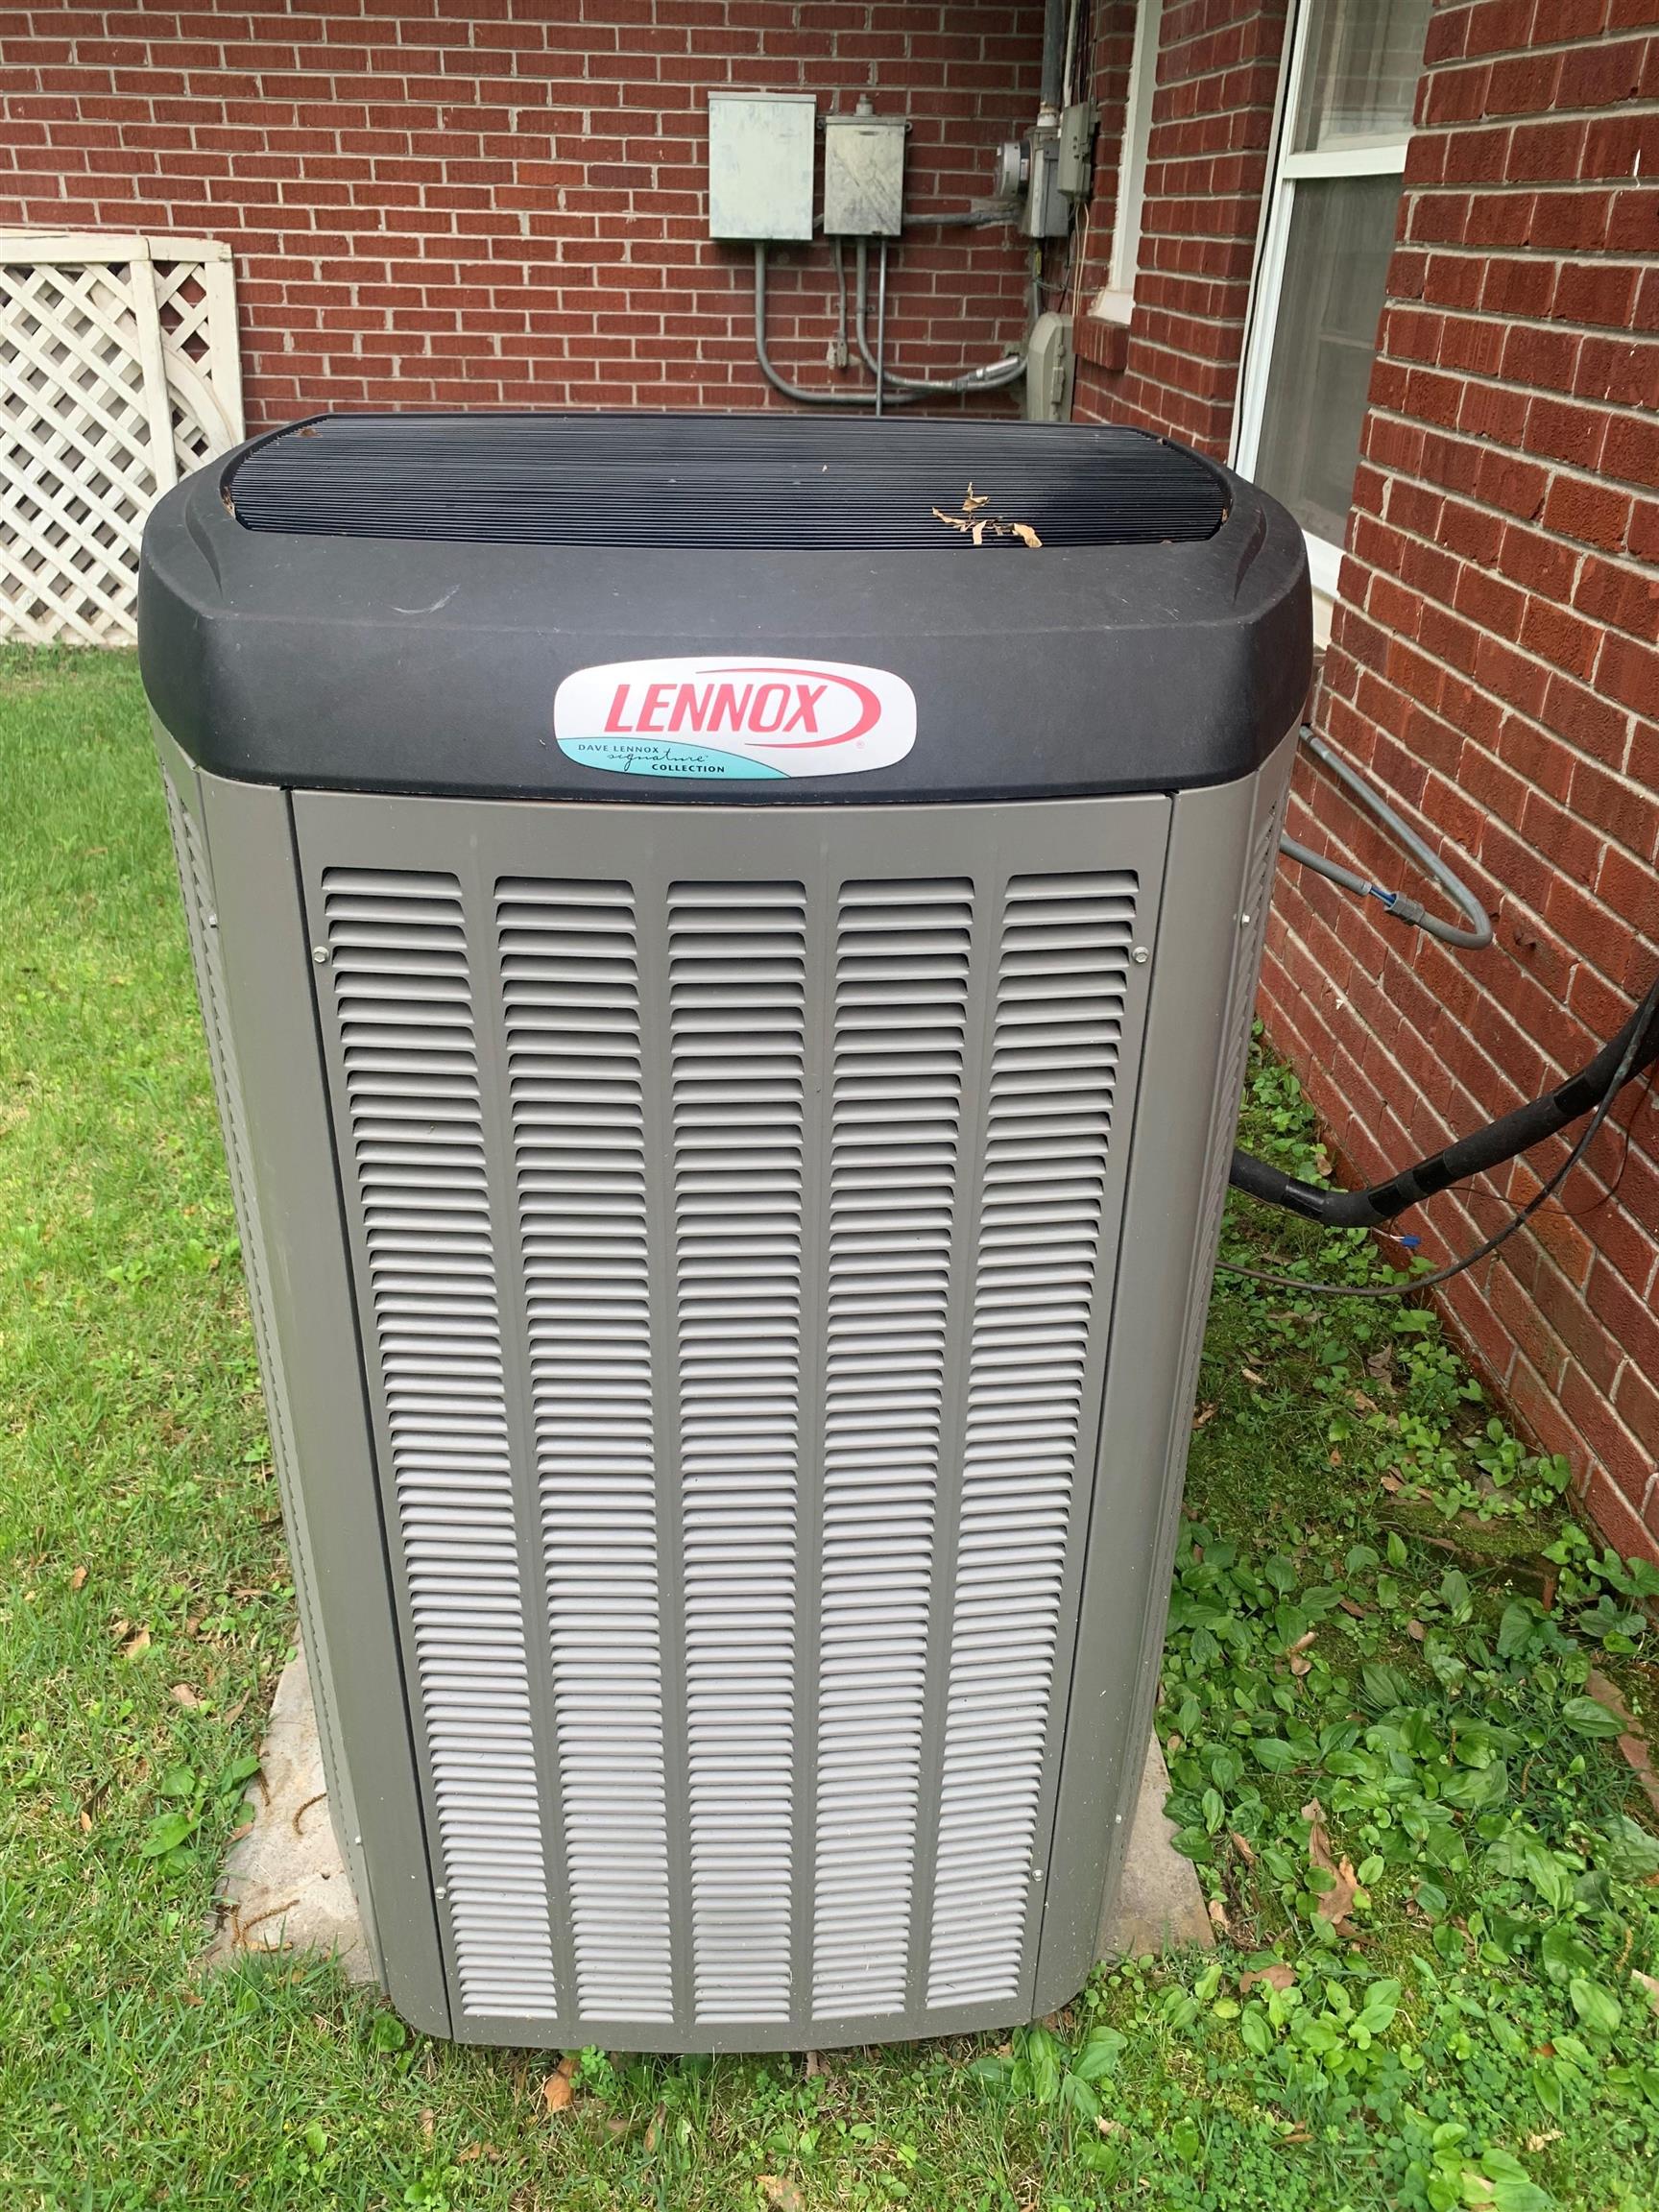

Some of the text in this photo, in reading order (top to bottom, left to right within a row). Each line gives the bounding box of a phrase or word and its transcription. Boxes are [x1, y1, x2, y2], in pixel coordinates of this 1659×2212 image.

[604, 684, 828, 733] LENNOX
[607, 748, 705, 771] signature
[651, 763, 725, 772] COLLECTION
